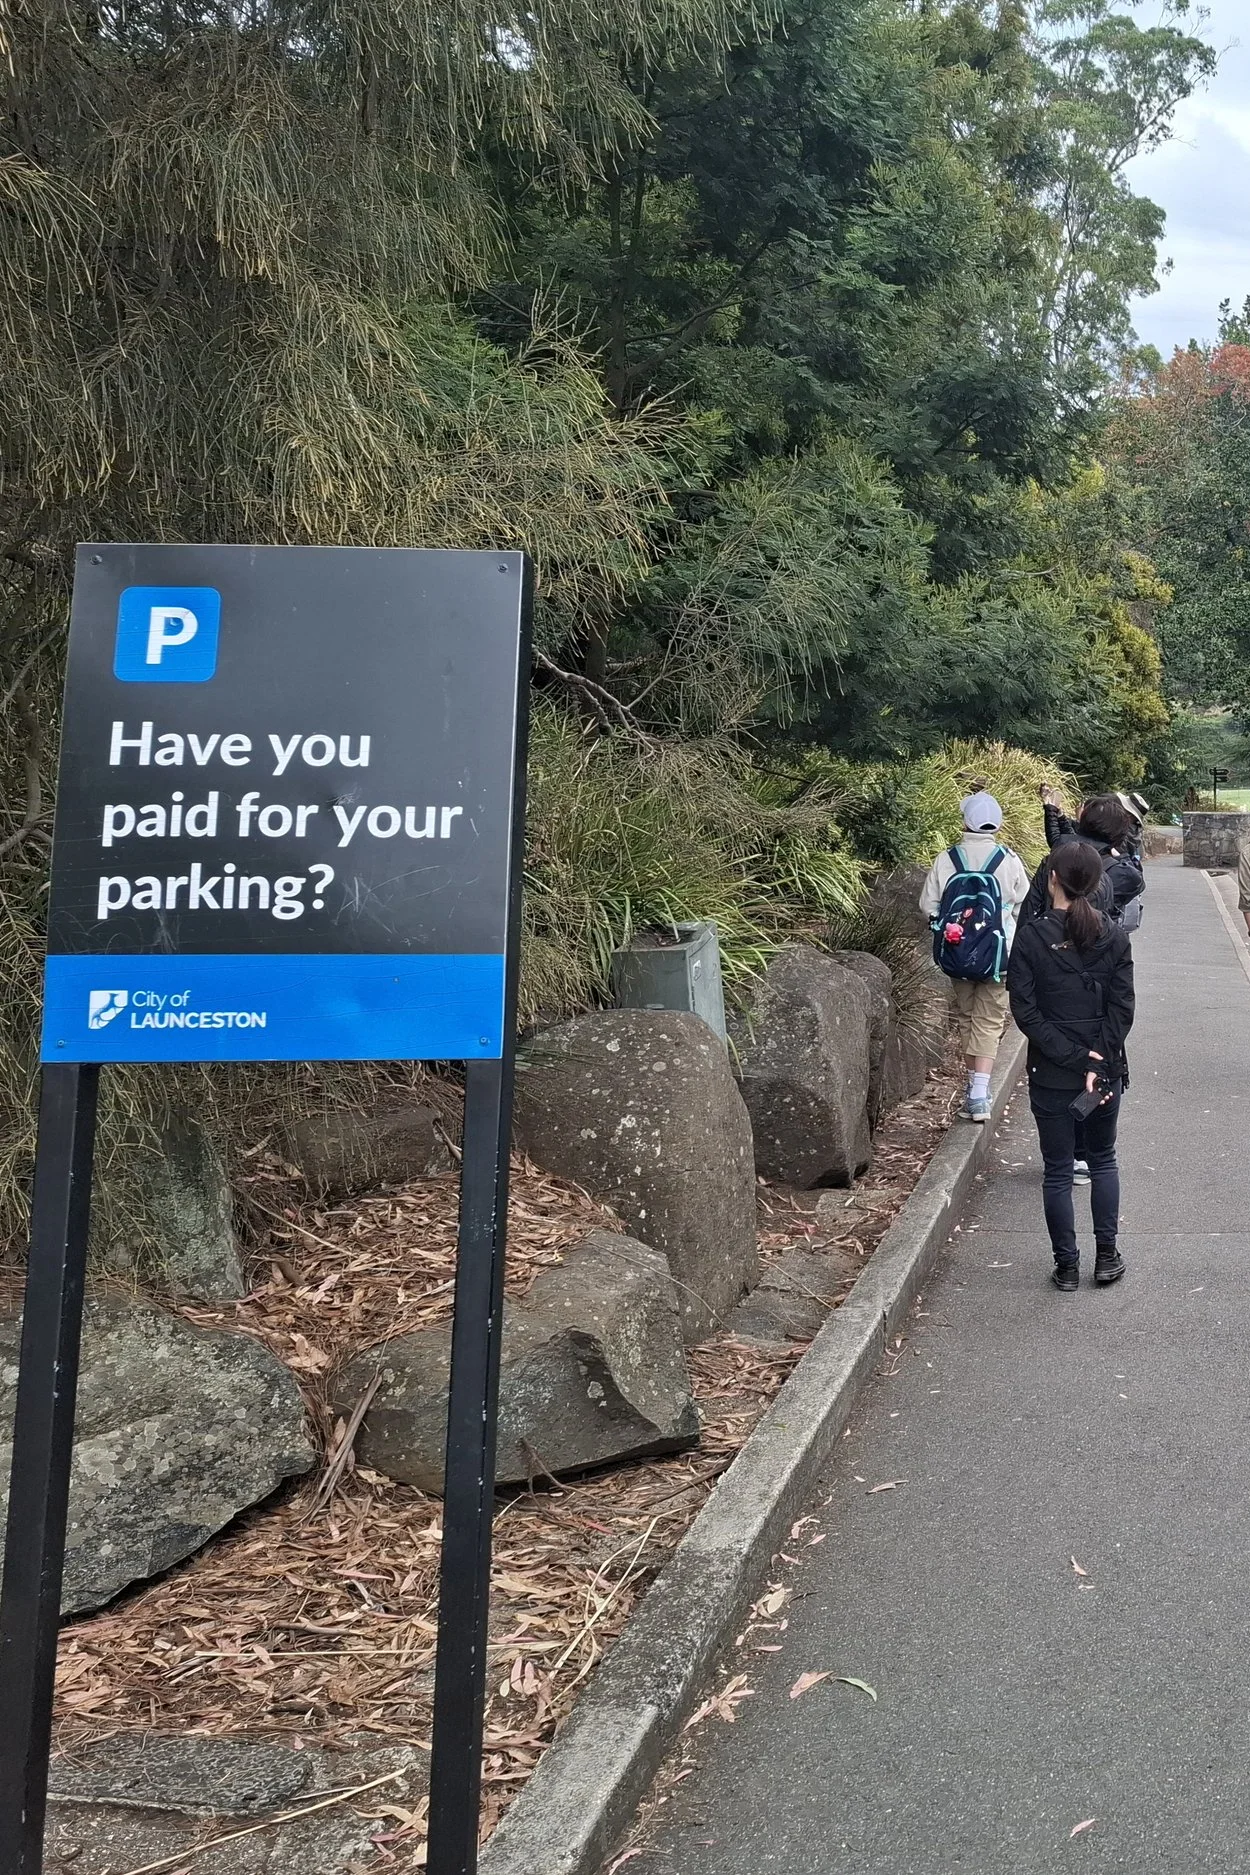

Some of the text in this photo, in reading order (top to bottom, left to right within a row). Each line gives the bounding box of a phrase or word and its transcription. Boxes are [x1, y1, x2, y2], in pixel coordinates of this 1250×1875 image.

[144, 606, 199, 665] P
[108, 721, 372, 776] Have you
[101, 791, 464, 848] paid for your
[96, 863, 336, 920] parking?
[130, 1011, 267, 1029] LAUNCESTON
[132, 989, 192, 1011] City of
